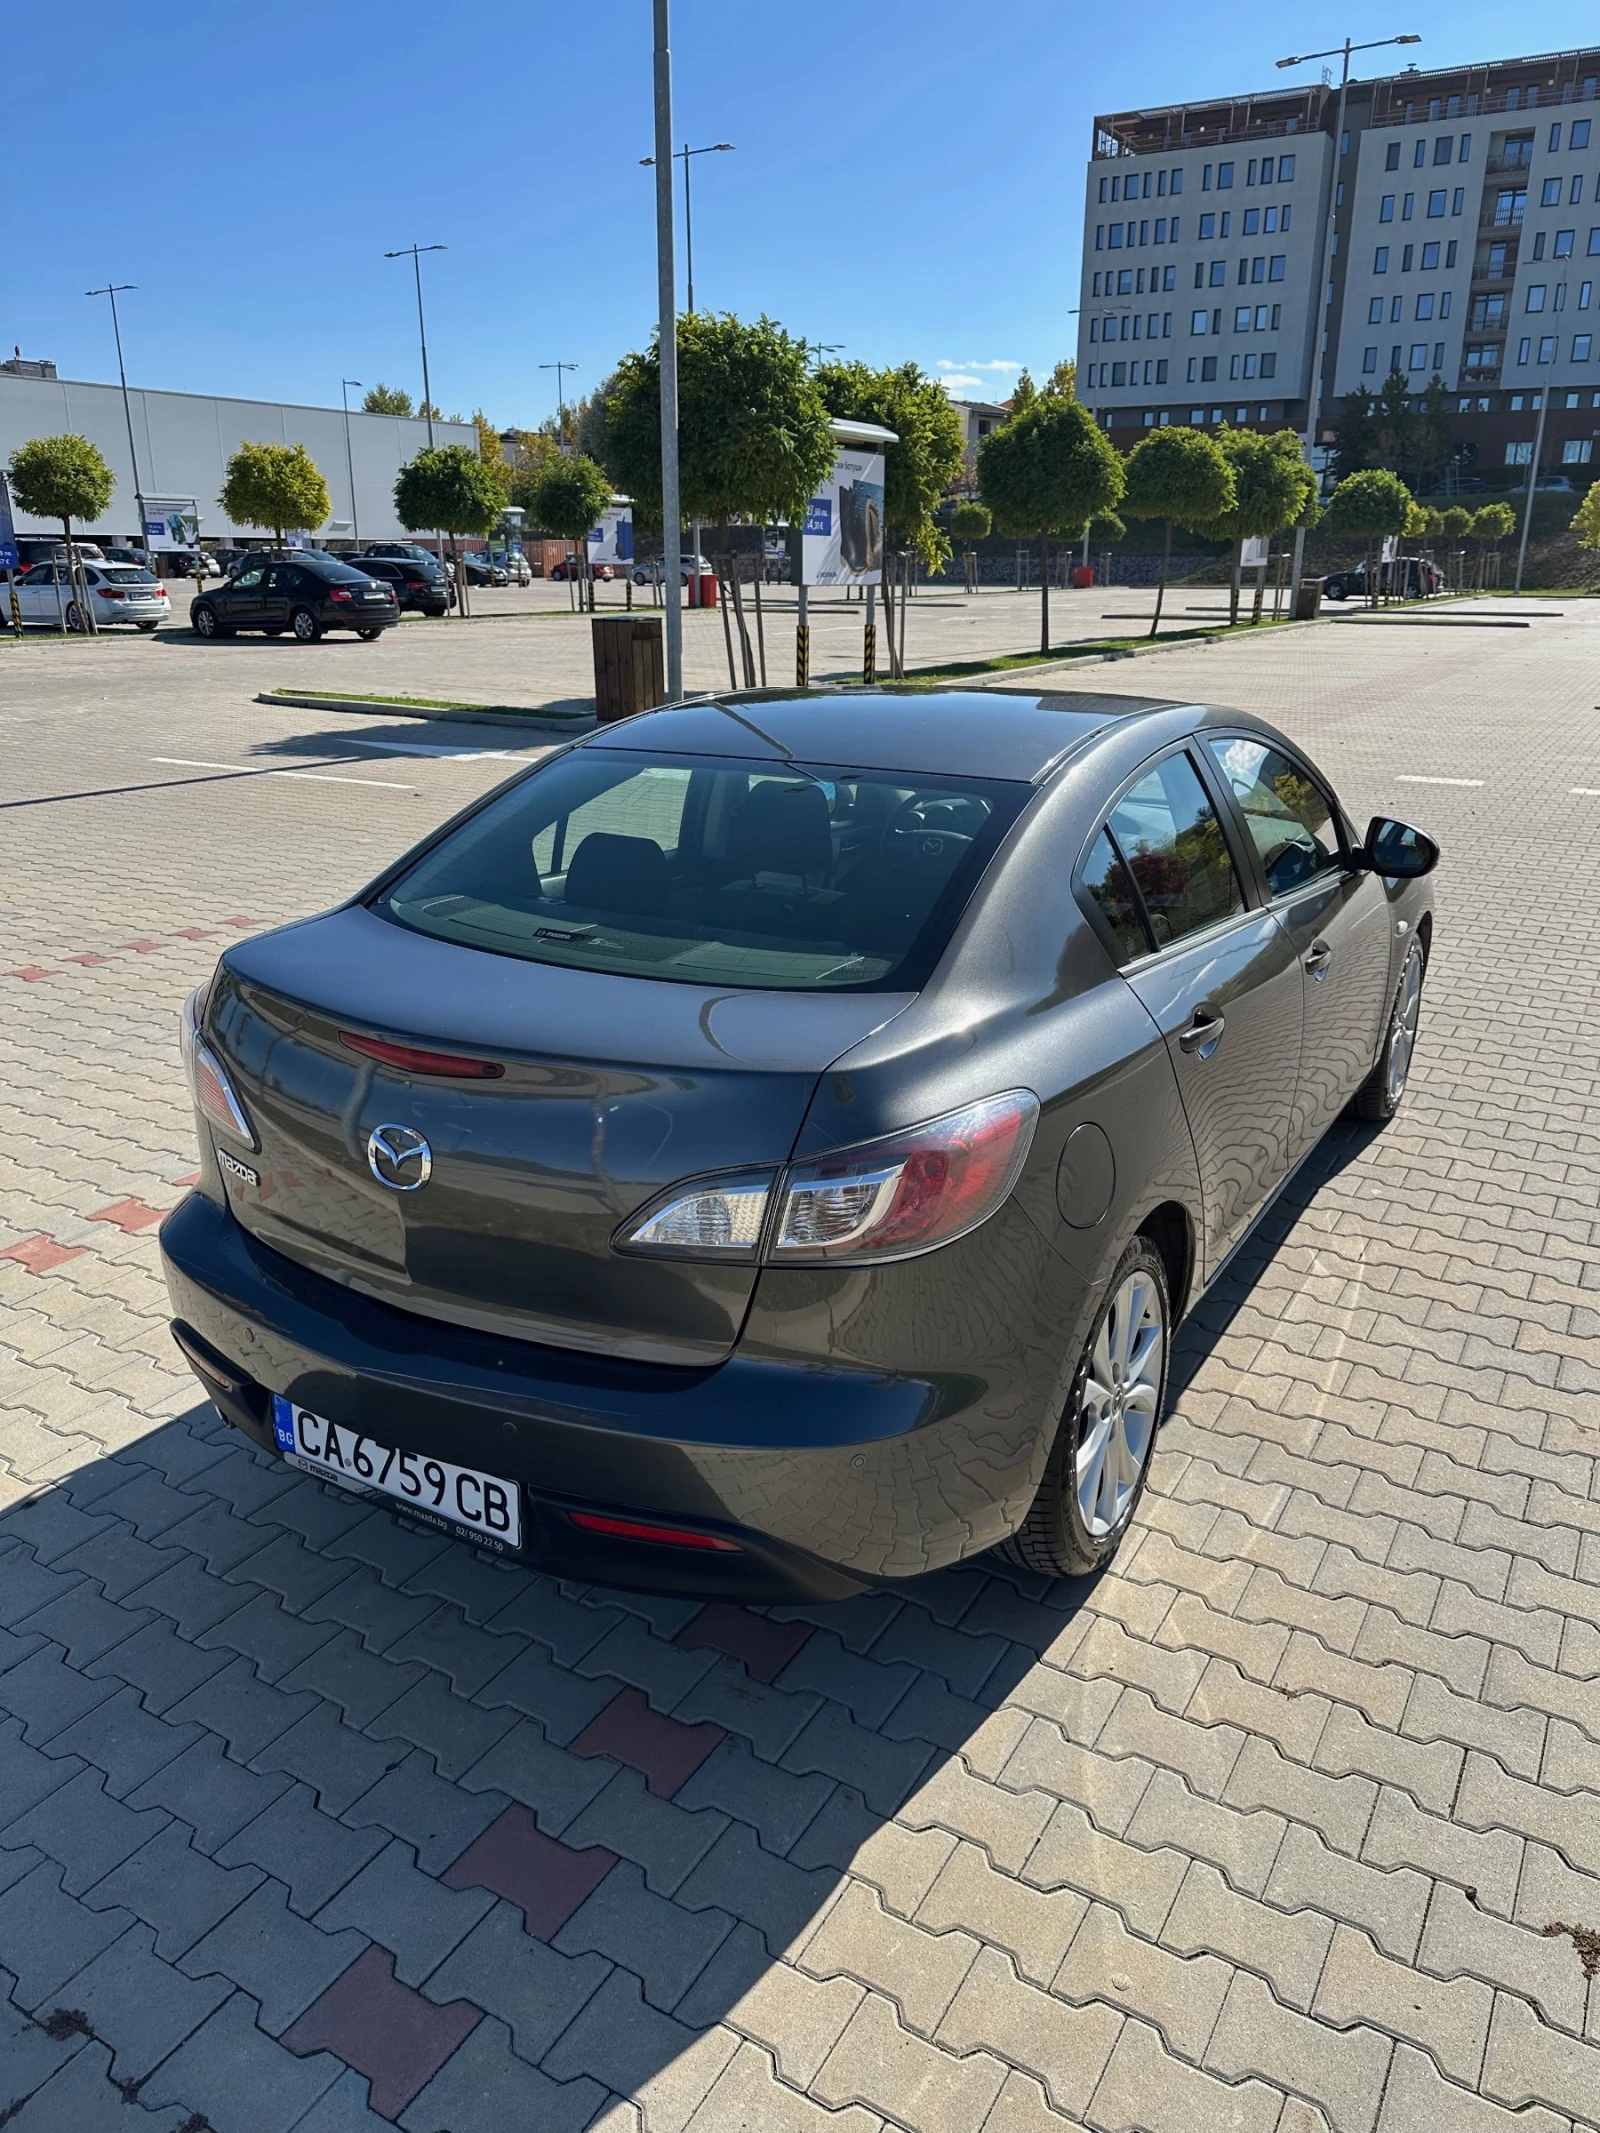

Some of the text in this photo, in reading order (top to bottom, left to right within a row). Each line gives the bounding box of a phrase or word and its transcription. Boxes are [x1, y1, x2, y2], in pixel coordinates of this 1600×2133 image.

[277, 1428, 294, 1445] BG
[395, 1502, 448, 1530] www.mazda.bg
[469, 1531, 483, 1543] 950
